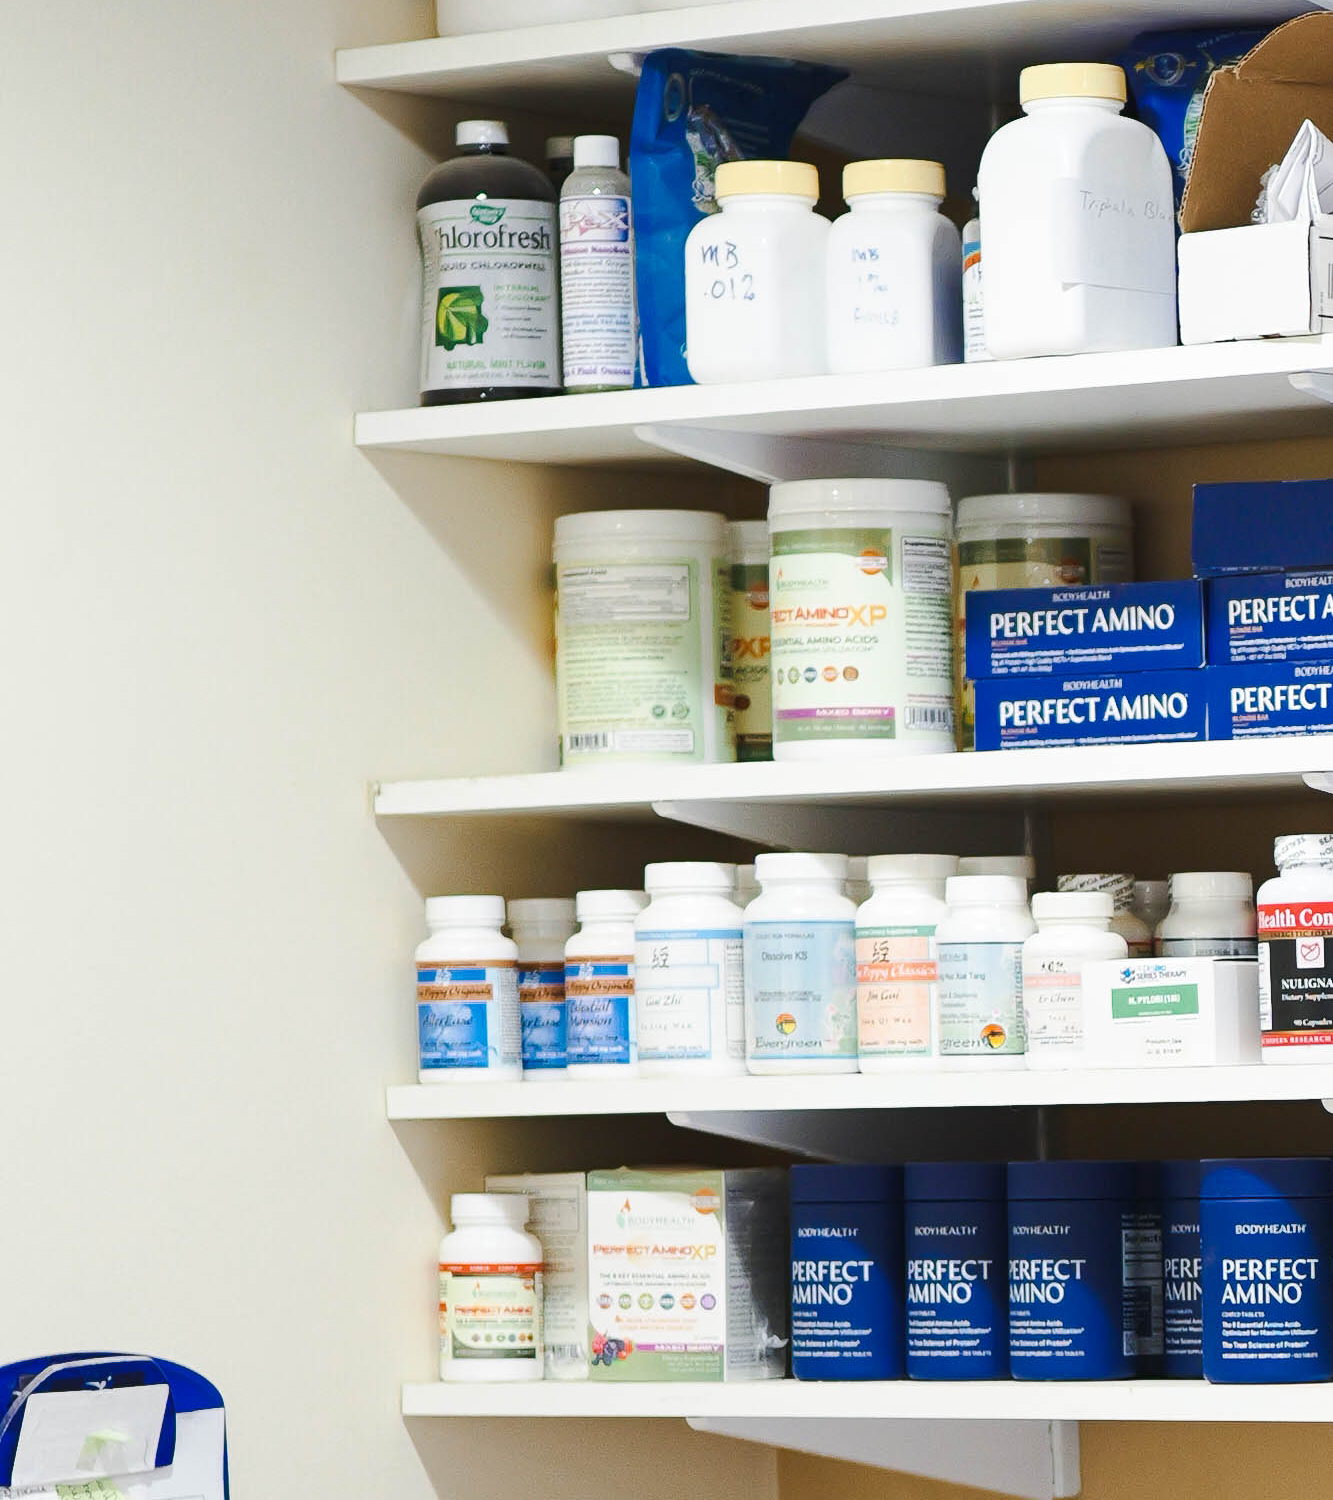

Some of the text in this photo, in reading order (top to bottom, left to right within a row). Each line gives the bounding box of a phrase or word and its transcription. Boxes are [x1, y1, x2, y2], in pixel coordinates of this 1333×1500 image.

[1228, 595, 1317, 625] PERFECT
[990, 605, 1174, 639] PERFECT AMINO
[1000, 692, 1188, 727] PERFECT AMINO
[1230, 682, 1330, 714] PERFECT
[1235, 1224, 1304, 1235] BODYHEALTH
[792, 1260, 874, 1283] PERFECT
[907, 1260, 992, 1282] PERFECT
[1221, 1259, 1319, 1282] PERFECT
[907, 1283, 970, 1305] AMINO
[1221, 1283, 1302, 1305] AMINO
